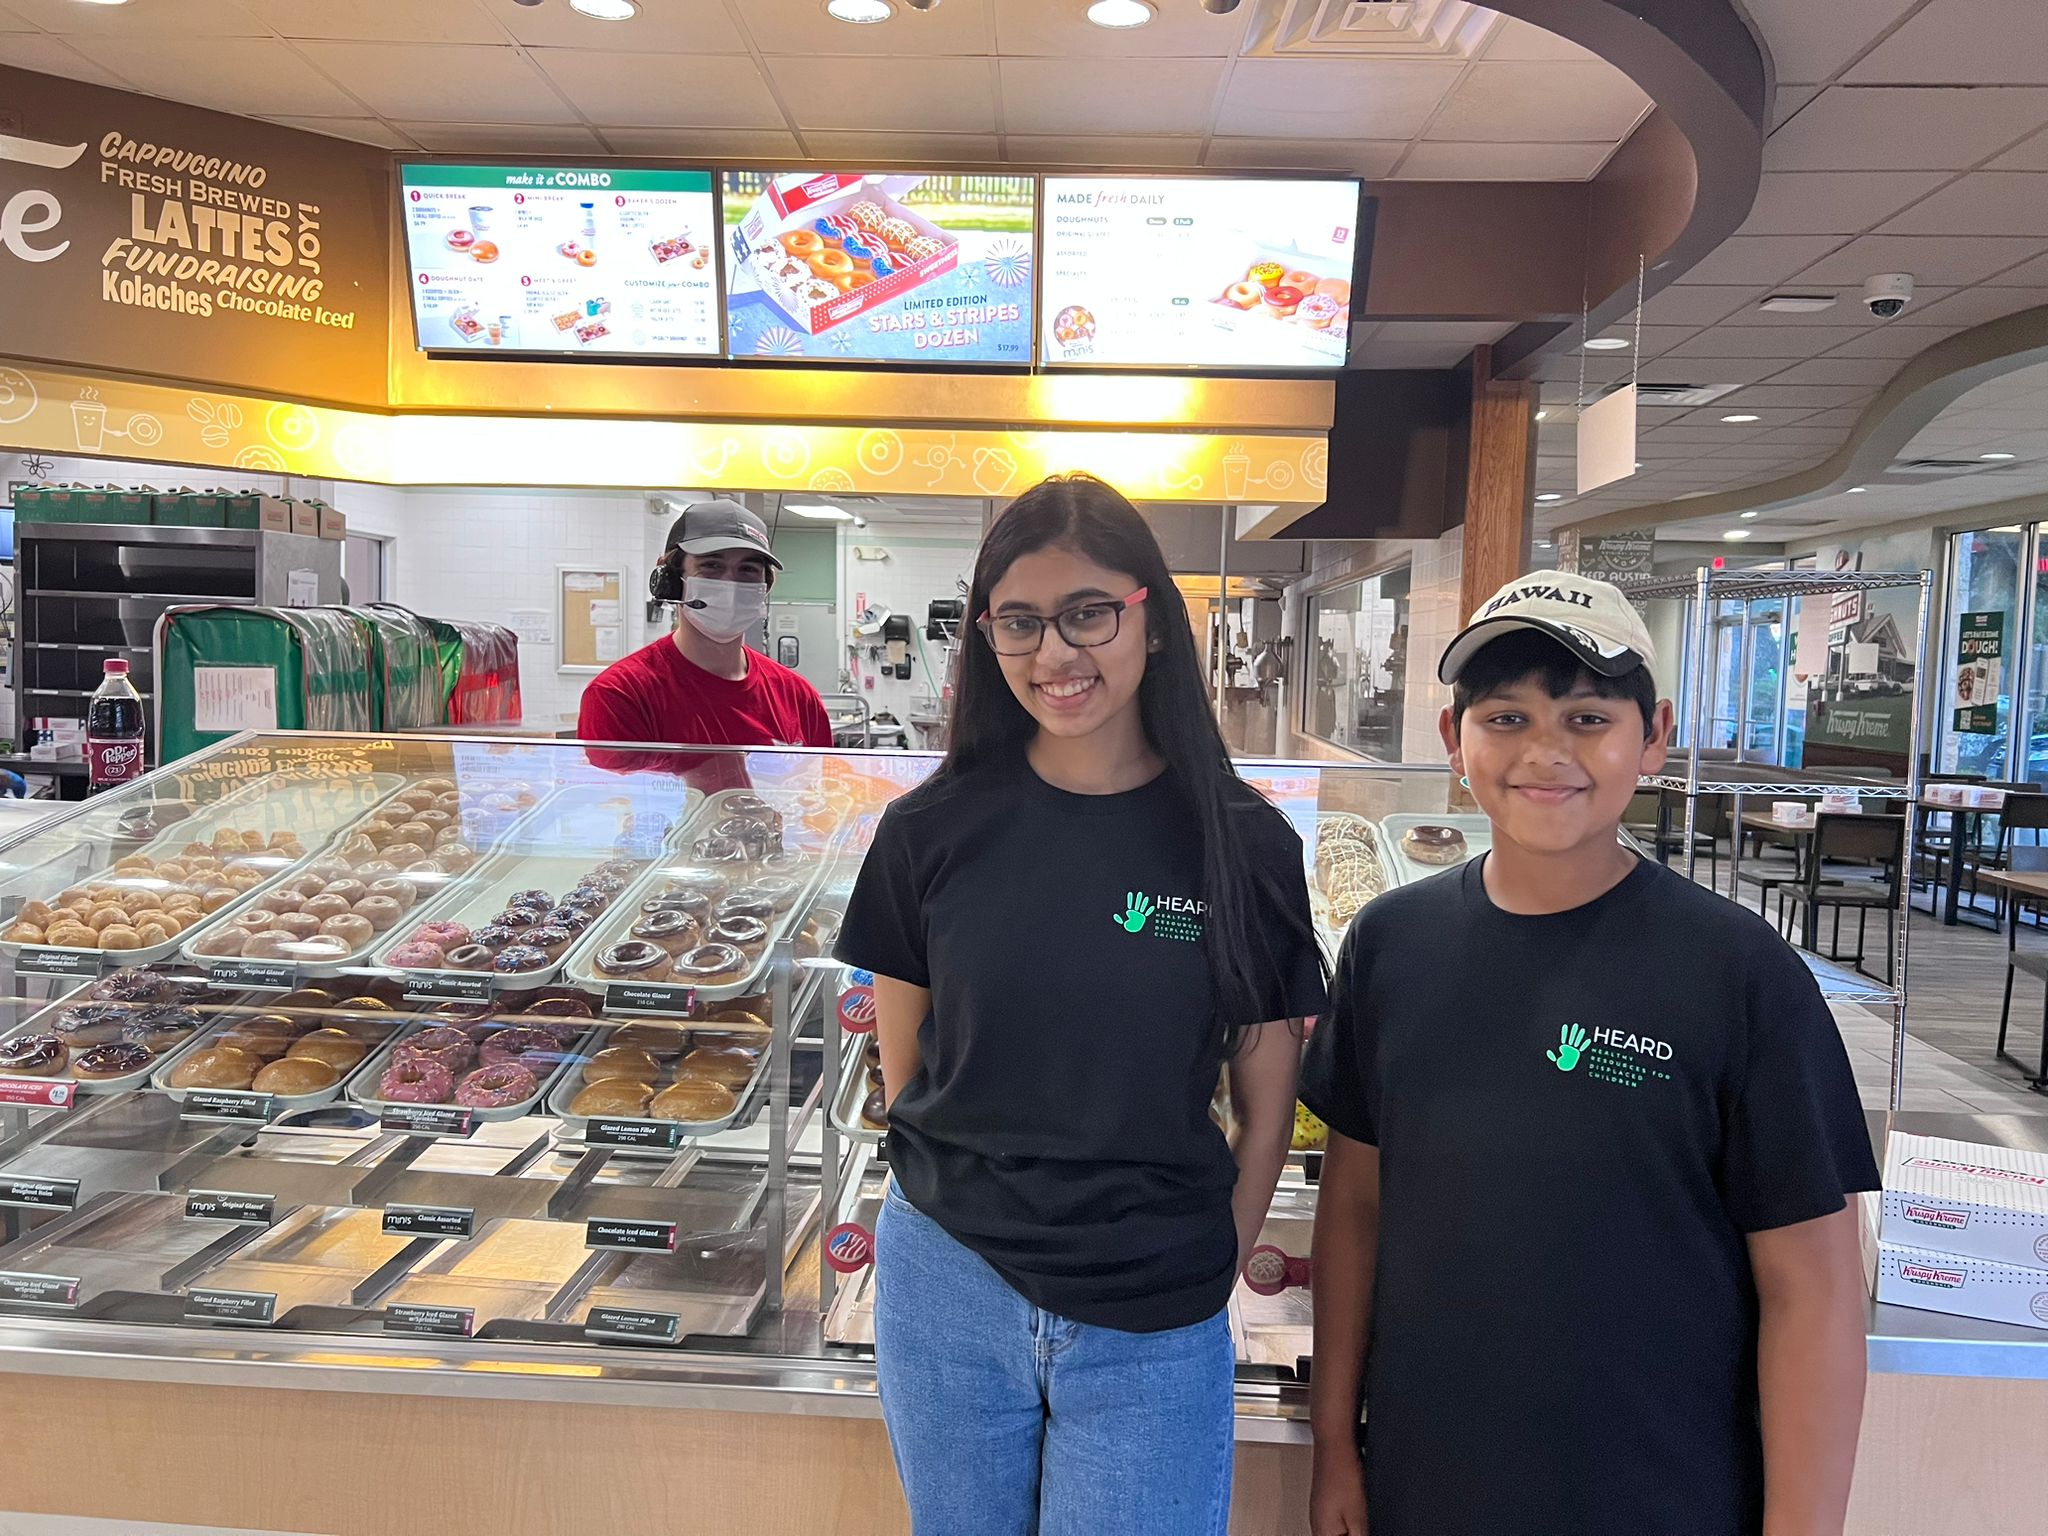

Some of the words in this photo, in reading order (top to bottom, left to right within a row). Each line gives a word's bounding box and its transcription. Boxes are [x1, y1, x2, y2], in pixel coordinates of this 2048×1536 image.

[506, 172, 533, 185] make
[536, 173, 544, 185] it
[546, 176, 554, 185] a
[555, 172, 612, 186] COMBO
[101, 161, 182, 197] FRESH
[190, 180, 291, 218] BREWED
[1057, 193, 1092, 204] MADE
[1094, 190, 1127, 207] fresh
[1130, 195, 1165, 205] DAILY
[131, 194, 294, 267] LATTES
[298, 203, 321, 275] JOY!
[101, 237, 324, 302] FUNDRAISING
[102, 270, 213, 318] Kolaches
[904, 299, 943, 310] LIMITED
[946, 295, 988, 307] EDITION
[216, 291, 312, 323] Chocolate
[315, 306, 355, 329] Iced
[868, 311, 926, 333] STARS
[929, 310, 944, 328] &
[946, 304, 1020, 326] STRIPES
[914, 327, 980, 349] DOZEN
[1484, 586, 1594, 617] HAWAII
[1961, 639, 1999, 655] DOUGH!
[1826, 709, 1858, 739] Krispy
[1856, 711, 1891, 737] Kreme
[106, 748, 135, 764] Pepper
[114, 746, 127, 756] Dr
[1593, 1026, 1673, 1061] HEARD
[1591, 1047, 1634, 1062] HEALTHY
[1589, 1063, 1644, 1081] DISPLACED
[1590, 1056, 1646, 1073] RESOURCES
[1652, 1070, 1671, 1080] FOR
[1589, 1071, 1637, 1088] CHILDREN
[191, 1202, 216, 1211] minis
[1906, 1206, 1937, 1221] Krispy
[1935, 1211, 1966, 1224] Kreme
[387, 1215, 412, 1224] minis
[598, 1227, 625, 1235] Chocolate
[1903, 1265, 1934, 1280] Krispy
[1932, 1270, 1963, 1284] Kreme
[213, 1297, 240, 1306] Raspberry
[395, 1309, 425, 1317] Strawberry
